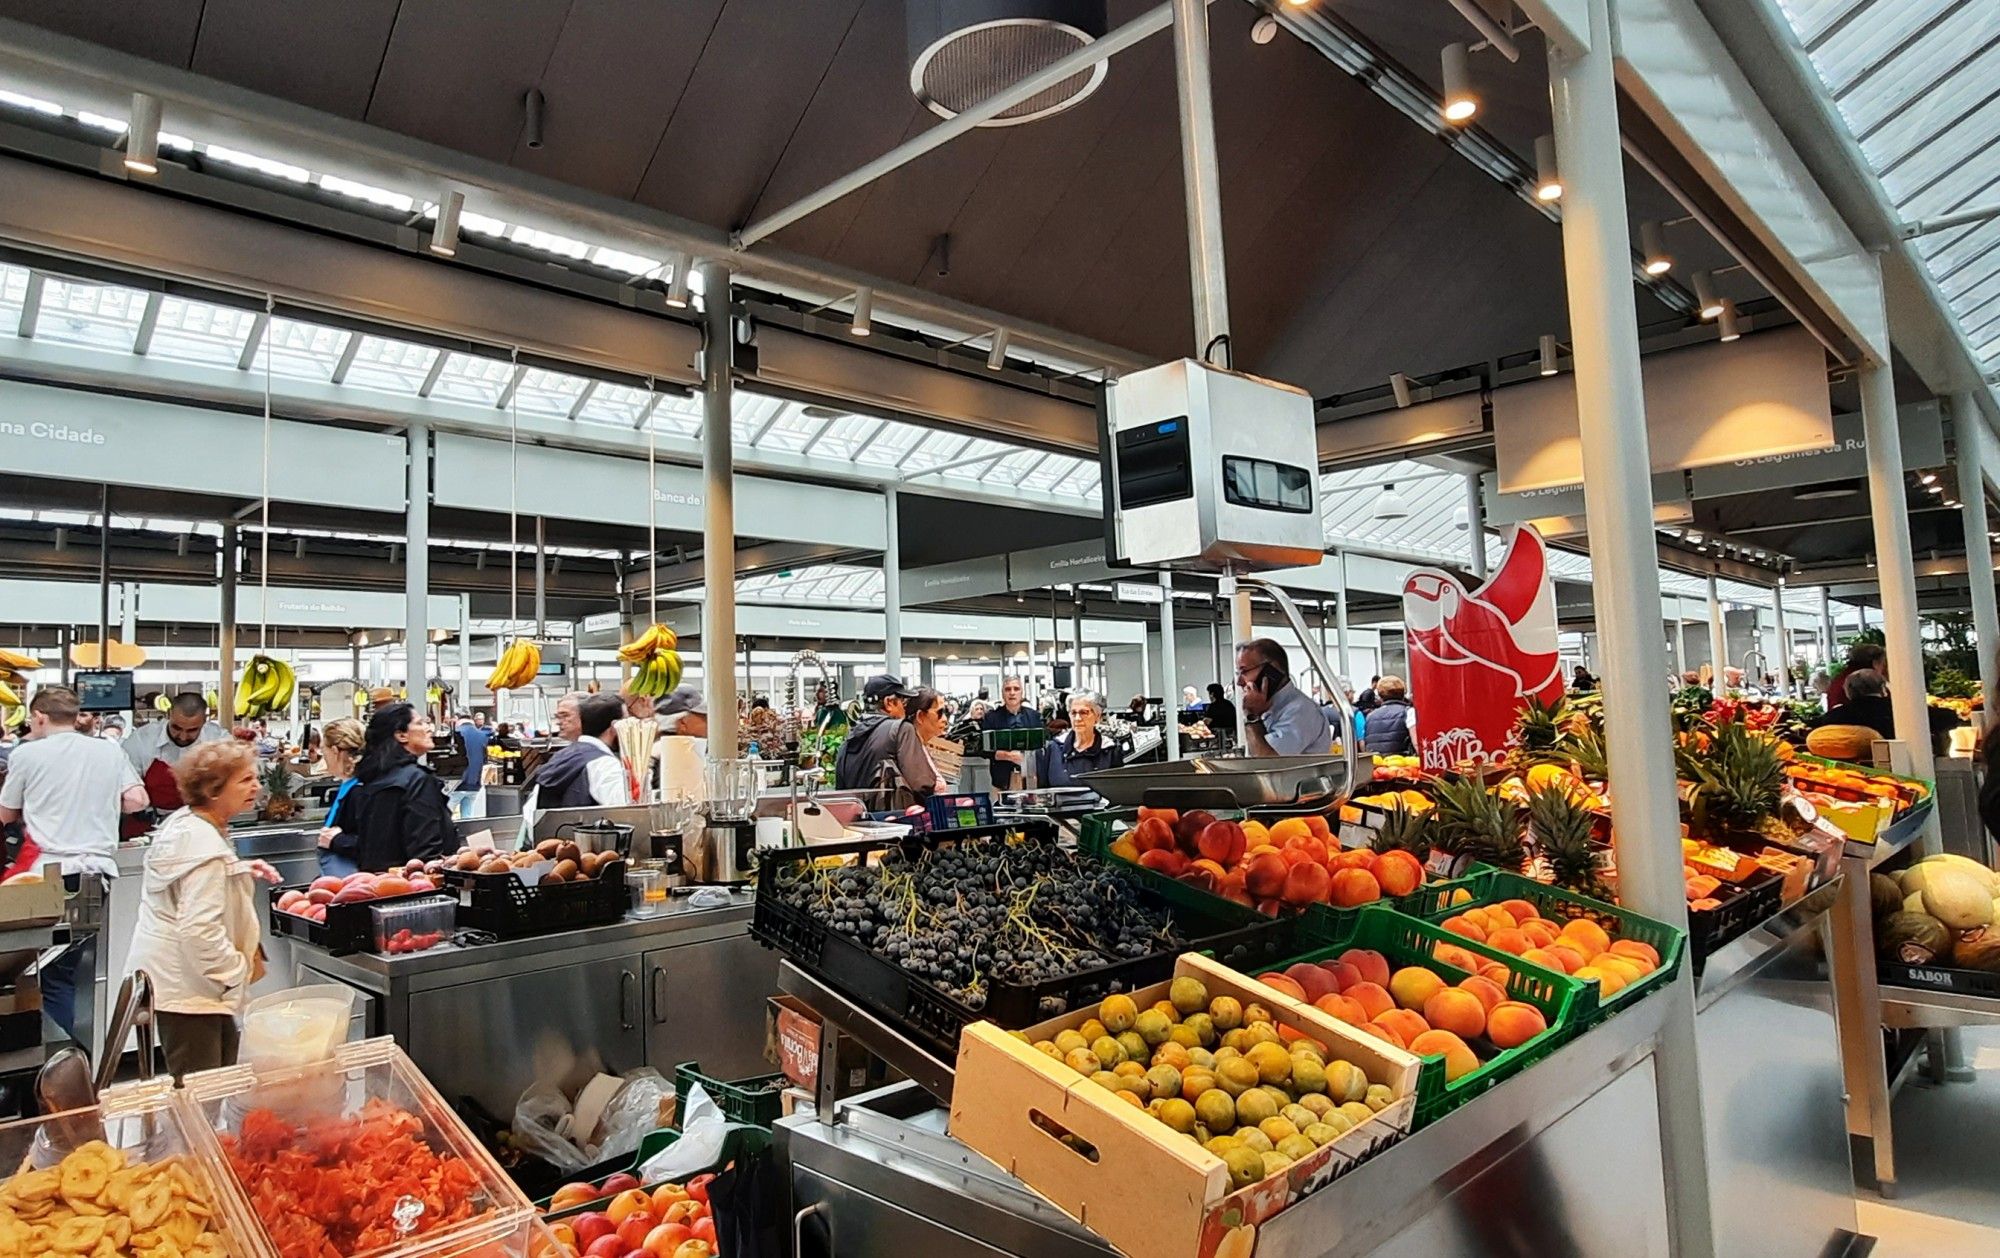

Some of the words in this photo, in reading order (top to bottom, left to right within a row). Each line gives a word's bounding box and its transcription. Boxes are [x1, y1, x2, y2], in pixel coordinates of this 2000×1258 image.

[30, 422, 105, 444] Cidade
[654, 489, 686, 504] Banca
[687, 494, 701, 505] de
[1908, 968, 1954, 985] SABOR
